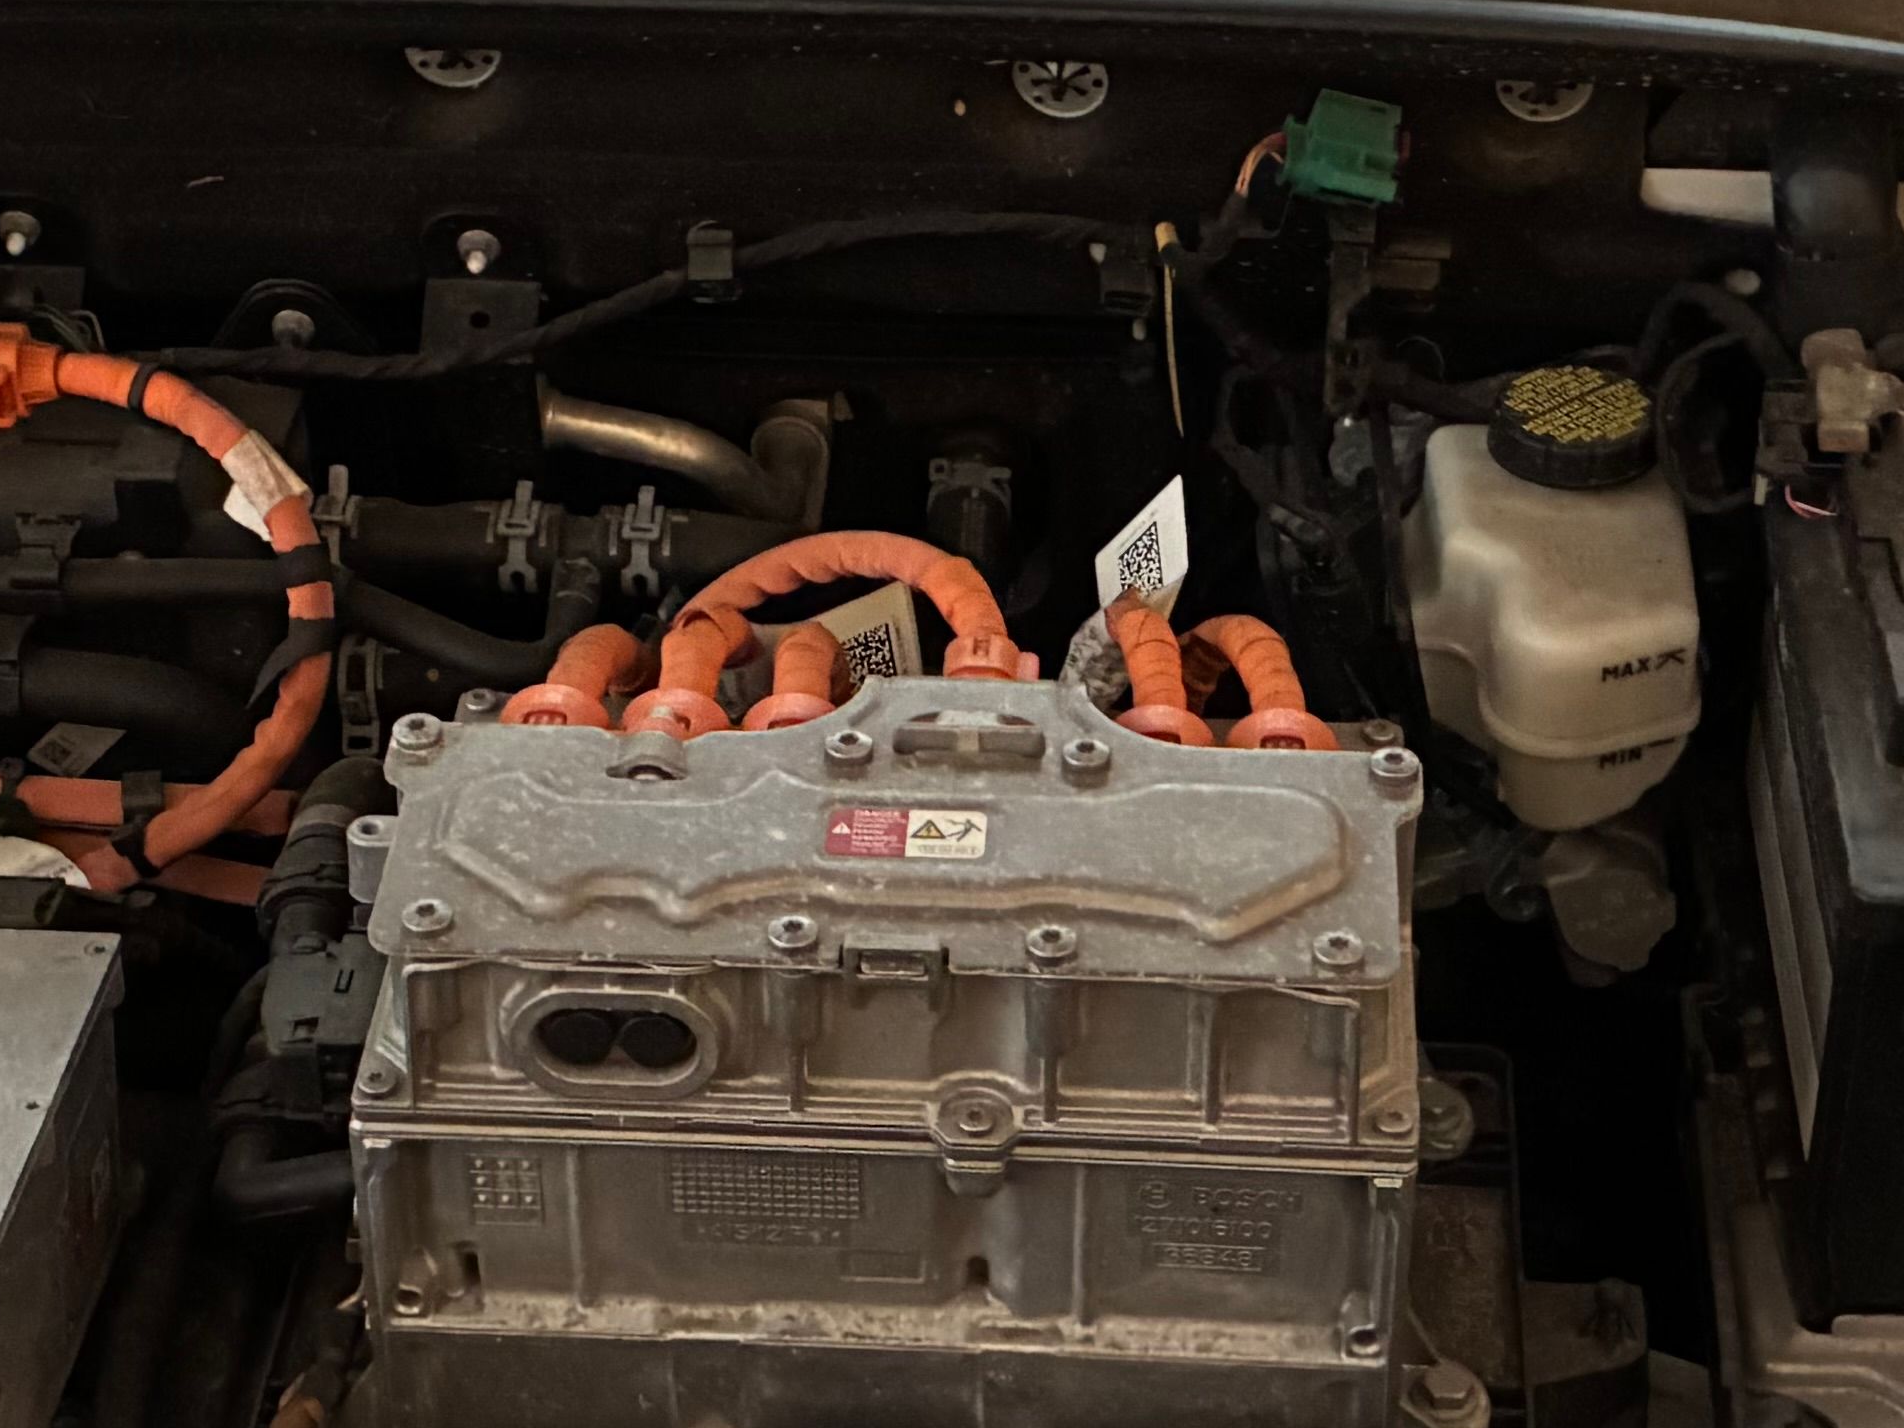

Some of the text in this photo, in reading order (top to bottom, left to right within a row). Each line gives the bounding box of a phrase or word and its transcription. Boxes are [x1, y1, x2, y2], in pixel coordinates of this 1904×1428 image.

[1601, 657, 1651, 682] MAX
[1599, 746, 1642, 769] MIN
[1193, 1186, 1302, 1211] BOSCH
